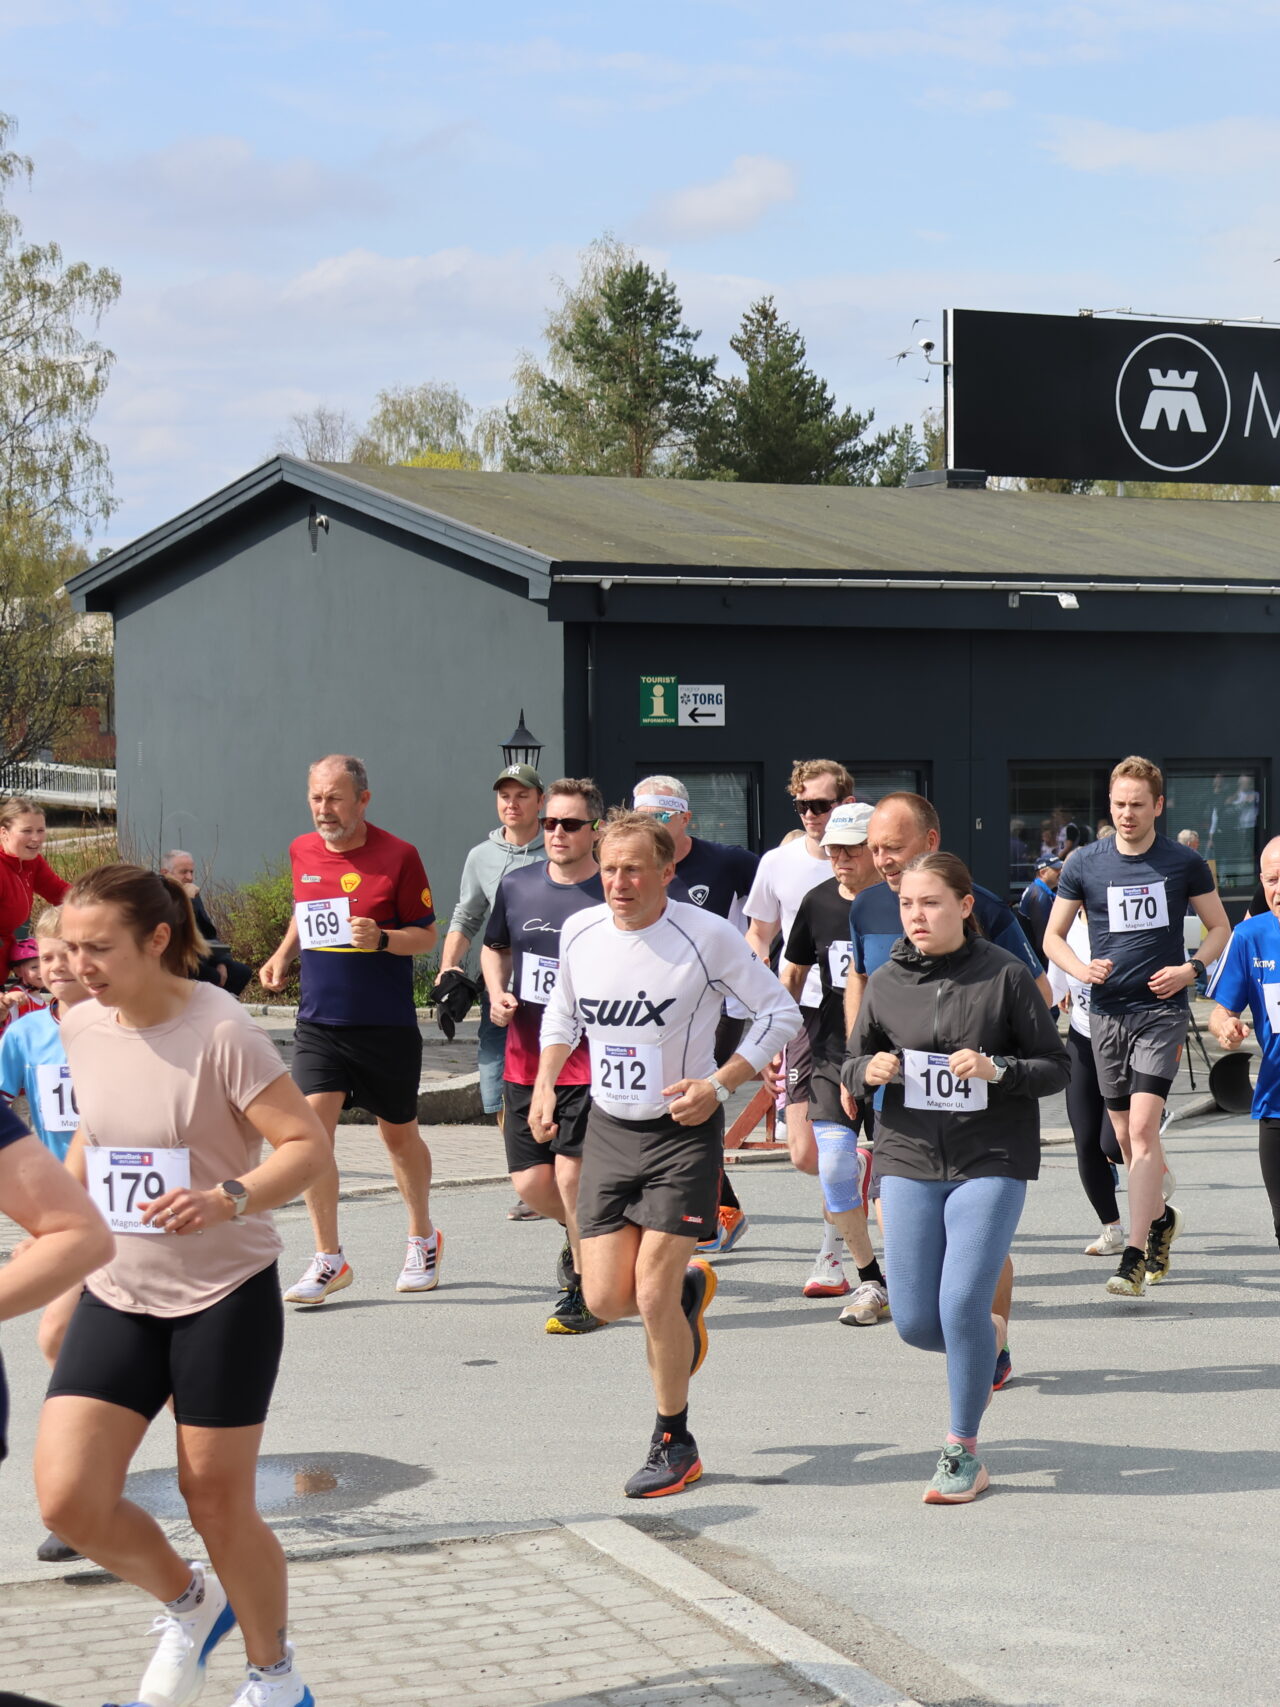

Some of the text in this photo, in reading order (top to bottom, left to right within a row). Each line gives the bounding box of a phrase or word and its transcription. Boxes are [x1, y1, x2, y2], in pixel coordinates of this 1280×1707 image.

[692, 693, 723, 705] TORG
[1119, 896, 1157, 921] 170
[304, 911, 340, 938] 169
[600, 1058, 647, 1091] 212
[920, 1068, 971, 1099] 104
[606, 1092, 629, 1100] Magnor
[927, 1100, 953, 1108] Magnor
[103, 1171, 166, 1213] 179
[111, 1219, 143, 1228] Magnor
